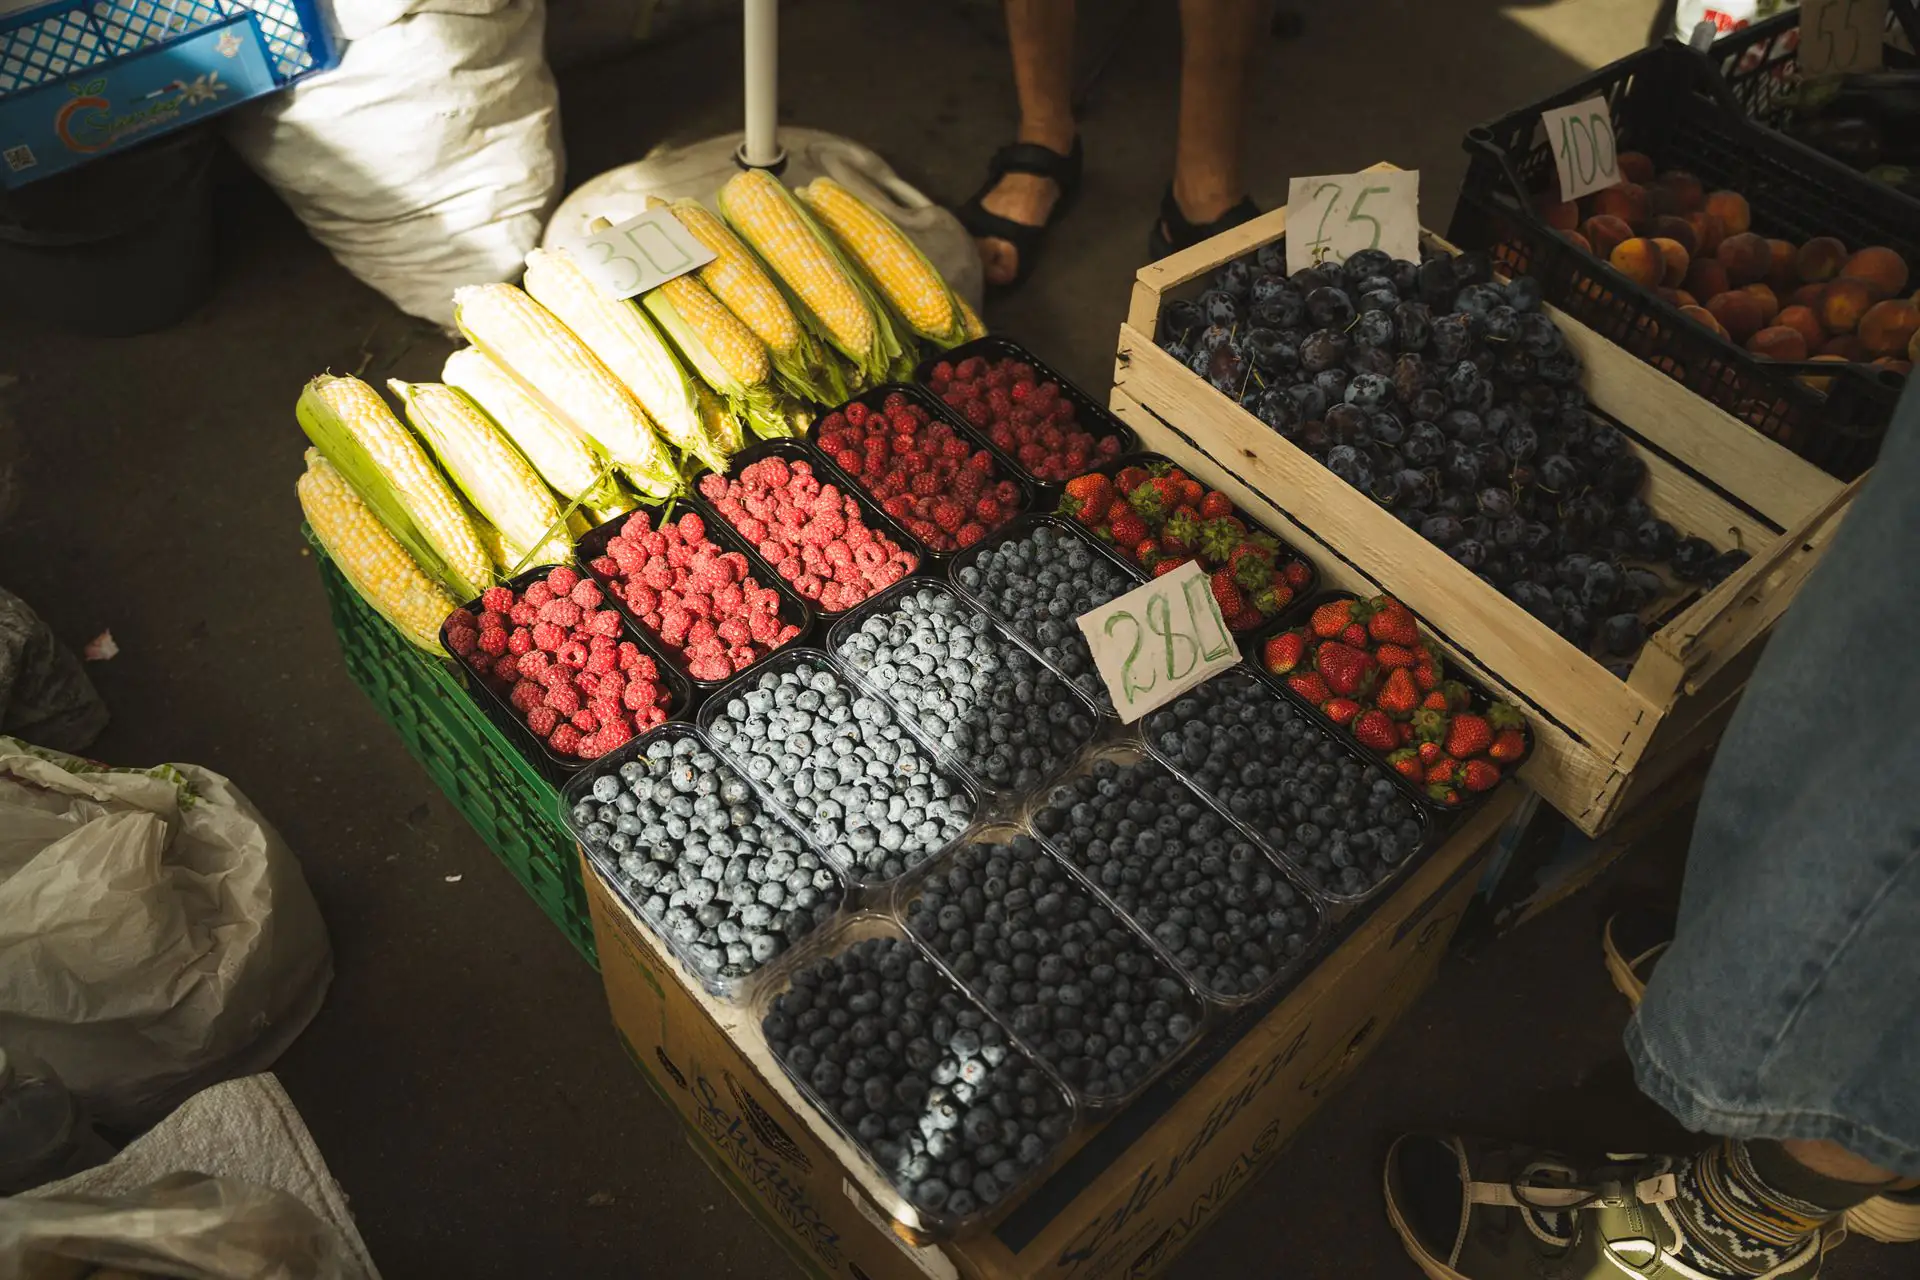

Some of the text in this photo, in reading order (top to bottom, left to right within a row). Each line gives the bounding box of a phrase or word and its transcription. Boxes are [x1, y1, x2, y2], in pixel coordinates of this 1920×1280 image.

[1560, 113, 1616, 195] 100
[586, 220, 695, 291] 30
[1304, 182, 1391, 262] 75
[1104, 573, 1233, 704] 280
